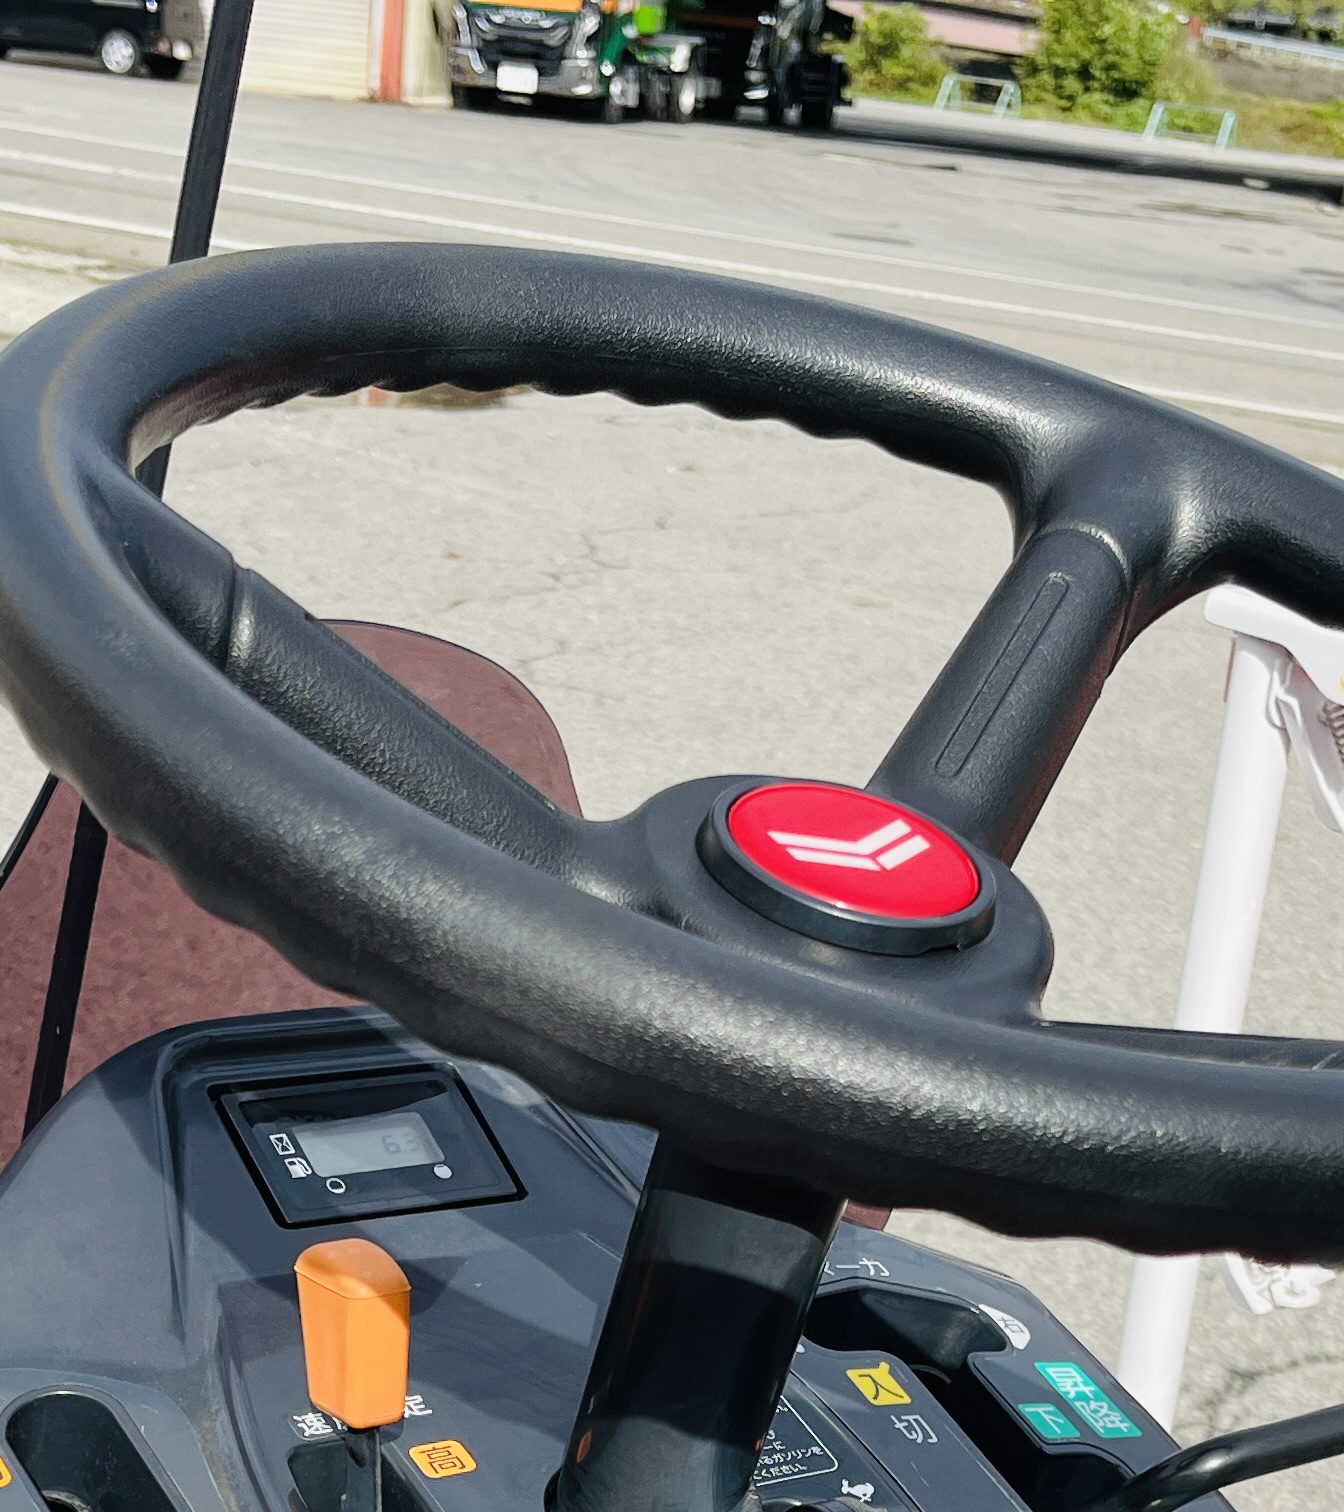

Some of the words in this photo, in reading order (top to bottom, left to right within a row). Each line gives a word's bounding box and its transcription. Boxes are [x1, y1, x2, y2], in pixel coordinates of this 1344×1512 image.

[858, 1373, 906, 1401] 入
[1044, 1366, 1131, 1434] 昇降
[891, 1413, 939, 1445] 切
[1024, 1405, 1063, 1435] 下
[417, 1445, 468, 1475] 高
